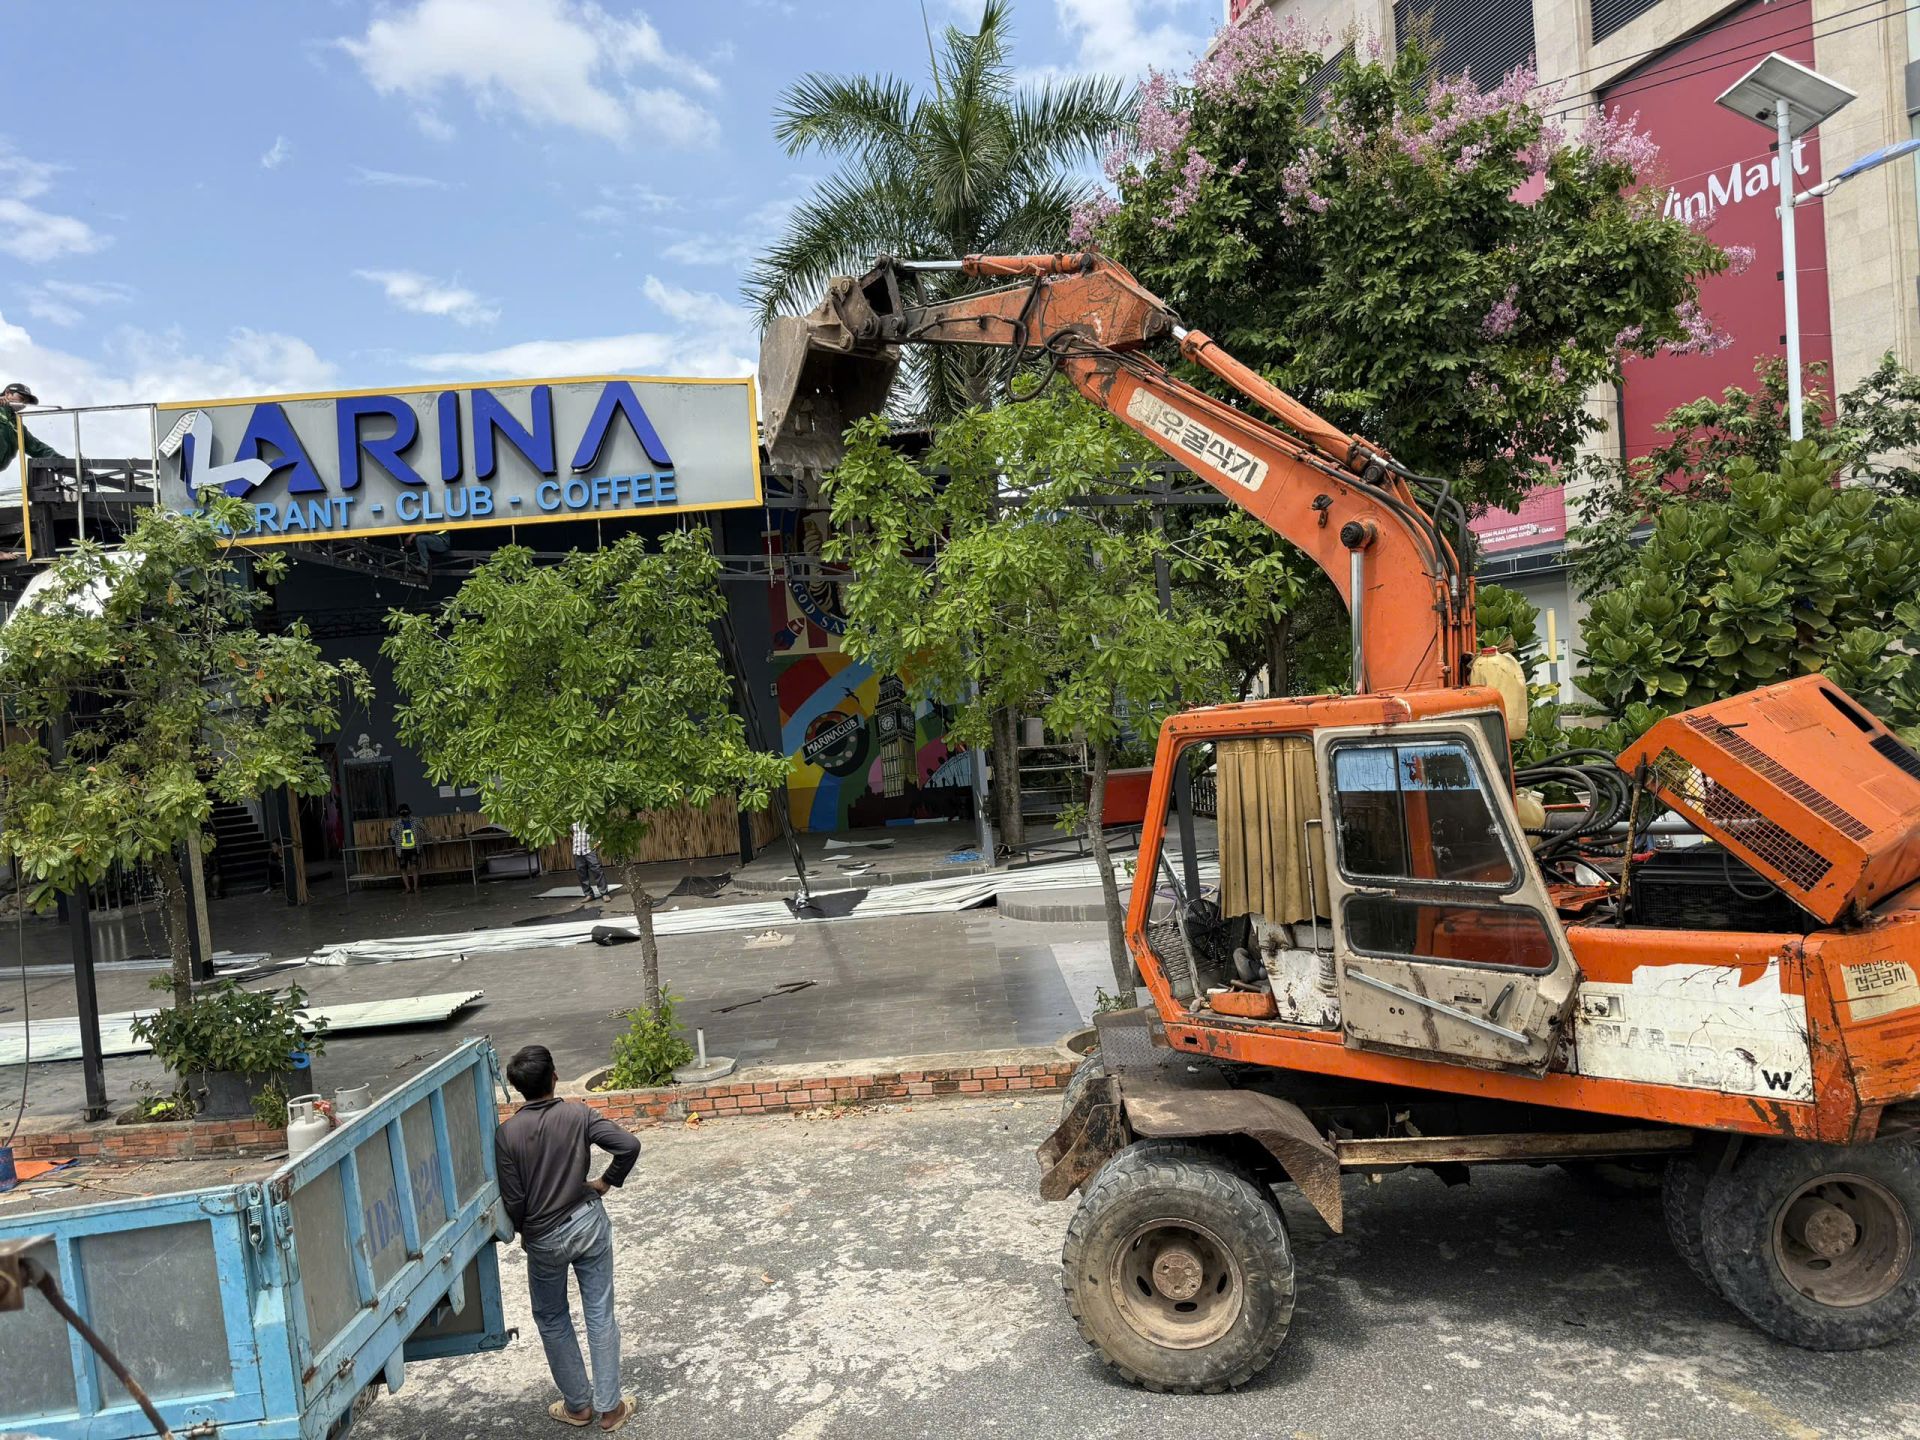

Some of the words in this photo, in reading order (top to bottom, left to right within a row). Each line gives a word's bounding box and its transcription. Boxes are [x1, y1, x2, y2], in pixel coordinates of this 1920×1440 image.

[1662, 139, 1809, 222] inMart
[395, 486, 494, 521] CLUB
[536, 471, 677, 511] COFFEE
[792, 583, 816, 614] GOD
[1854, 967, 1907, 992] 접근금지
